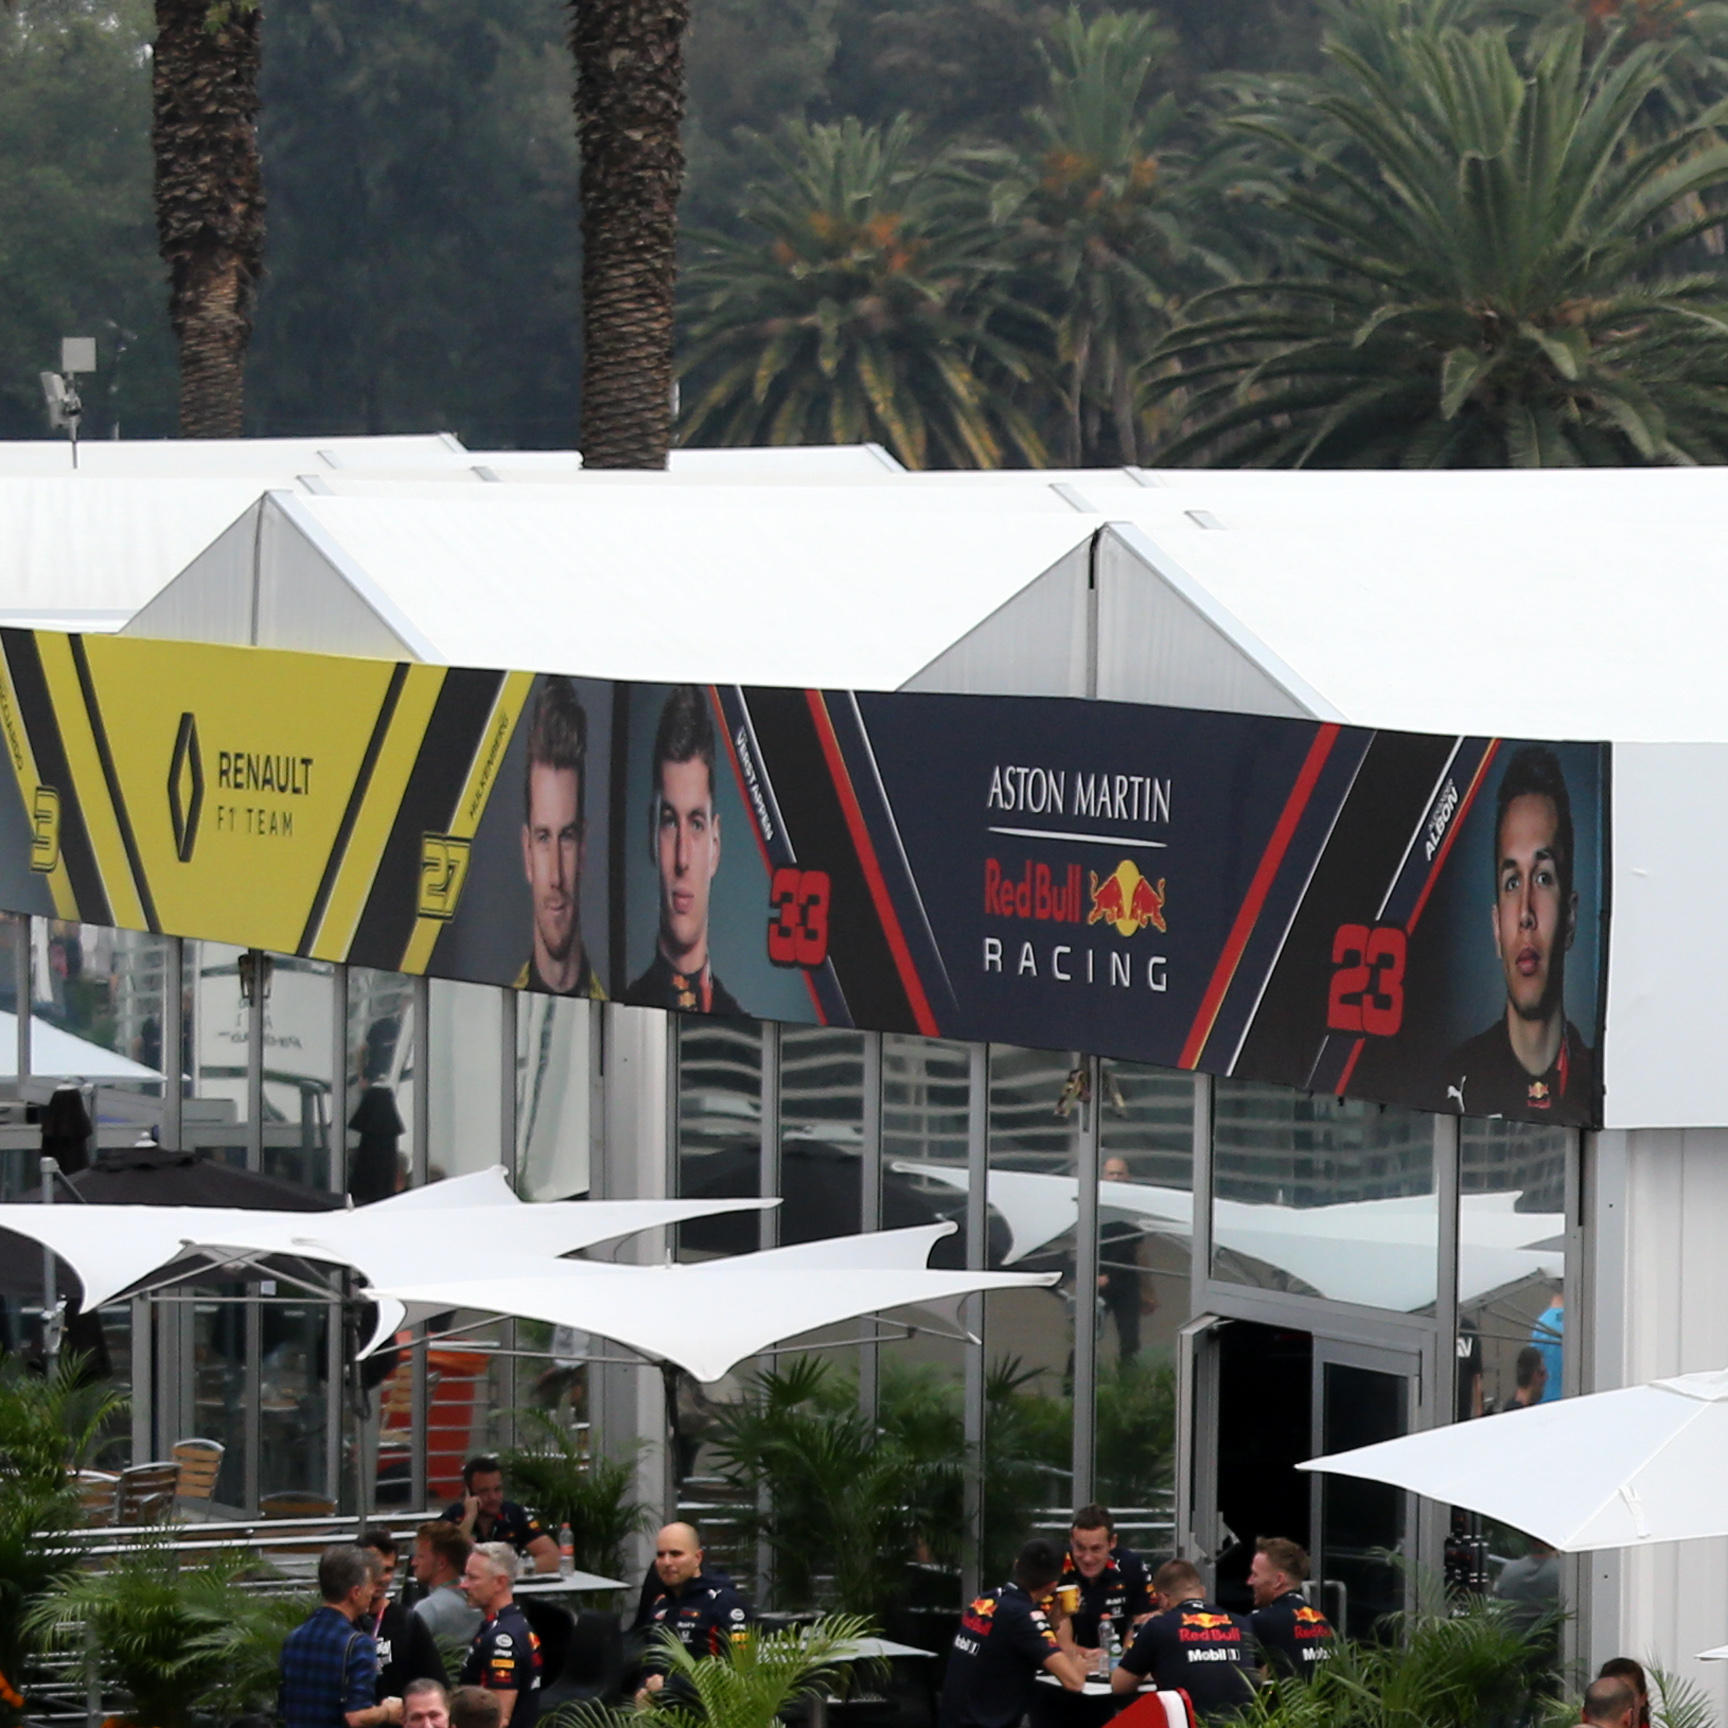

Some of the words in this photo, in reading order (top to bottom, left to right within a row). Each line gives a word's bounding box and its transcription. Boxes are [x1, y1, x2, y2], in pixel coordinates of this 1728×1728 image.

[218, 751, 313, 797] RENAULT
[987, 765, 1065, 815] ASTON
[1073, 771, 1172, 823] MARTIN
[31, 786, 60, 873] 3
[217, 805, 234, 831] F1
[243, 810, 294, 837] TEAM
[1426, 786, 1458, 861] ALBON
[417, 832, 473, 922] 27
[984, 859, 1033, 918] Red
[1035, 863, 1082, 923] Bull
[768, 868, 831, 965] 33
[983, 937, 1169, 992] RACING
[1327, 922, 1407, 1037] 23
[1178, 1628, 1209, 1642] Red
[1211, 1628, 1241, 1642] Bull
[1187, 1648, 1226, 1662] Mobil
